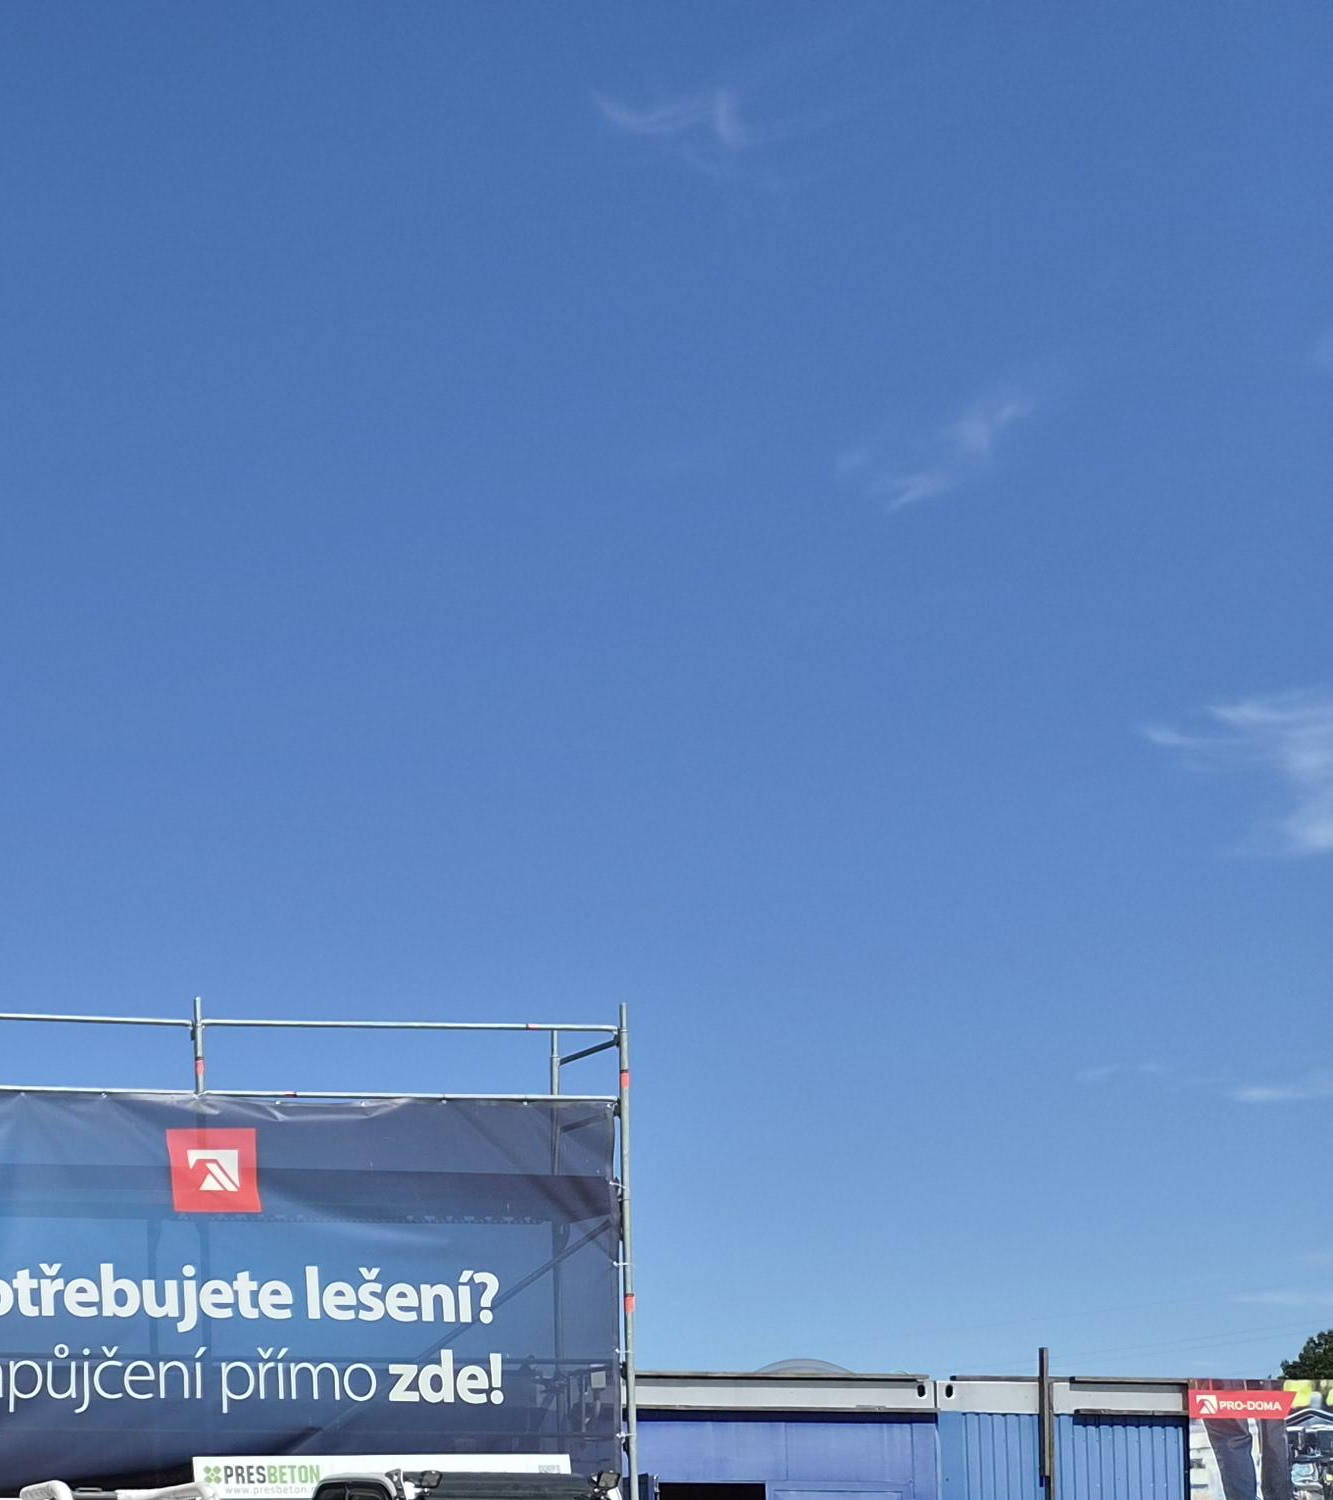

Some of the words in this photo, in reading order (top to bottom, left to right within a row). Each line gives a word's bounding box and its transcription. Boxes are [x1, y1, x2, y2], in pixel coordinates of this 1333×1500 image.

[305, 1266, 500, 1324] lešení?
[221, 1347, 377, 1414] přímo
[388, 1350, 504, 1405] zde!
[1219, 1400, 1282, 1411] PRO-DOMA
[223, 1465, 320, 1484] PRESBETON
